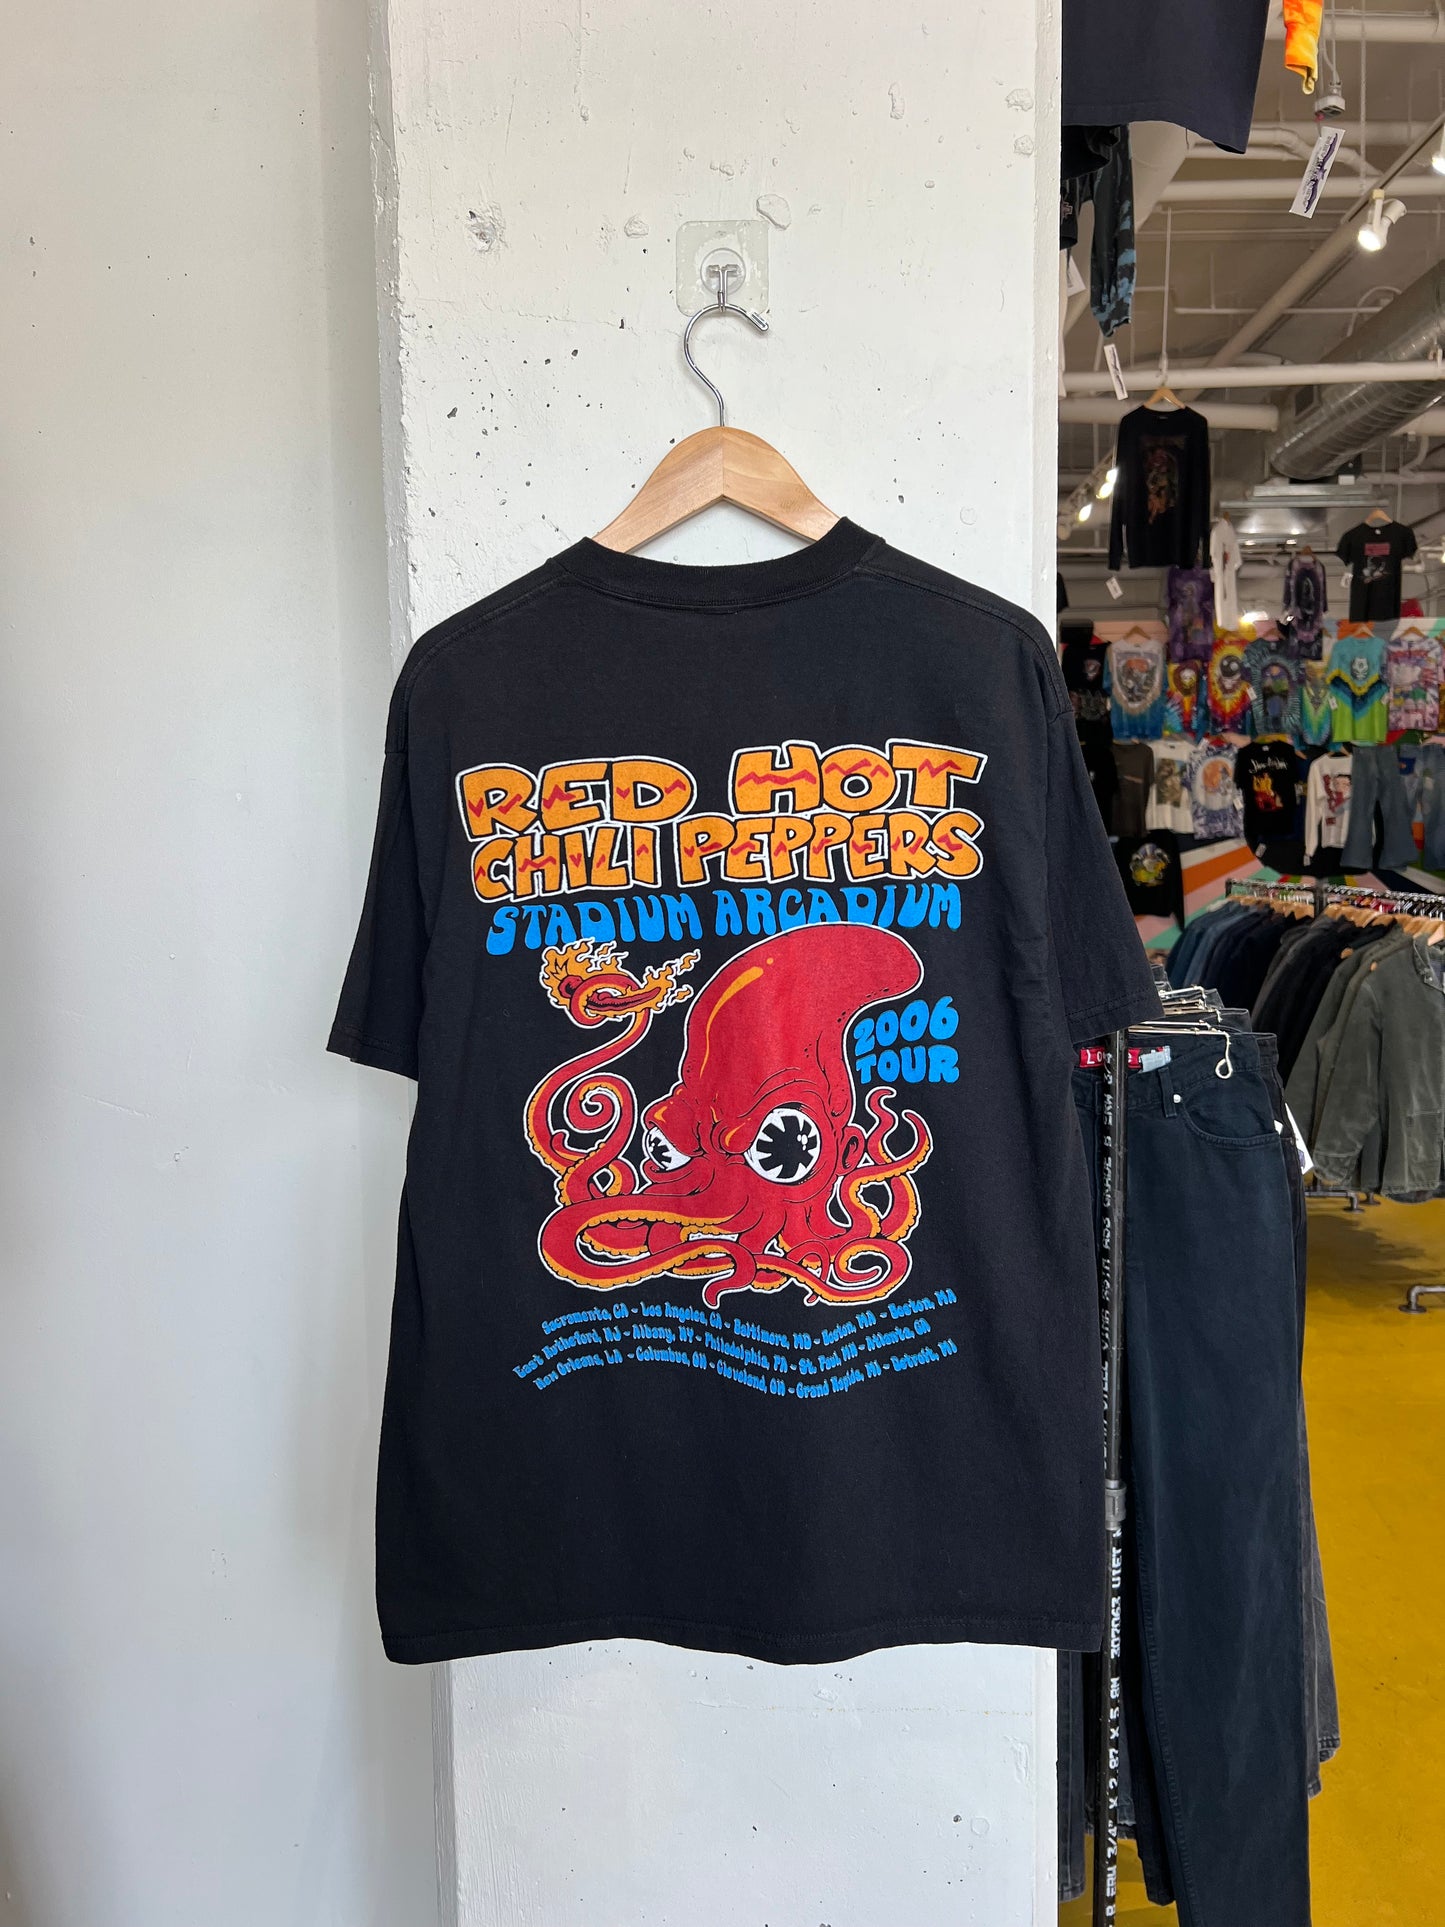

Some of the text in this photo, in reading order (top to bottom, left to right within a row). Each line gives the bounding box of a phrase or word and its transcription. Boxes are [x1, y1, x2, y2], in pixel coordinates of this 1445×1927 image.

[456, 739, 987, 840] RED HOT
[471, 809, 984, 902] CHILI PEPPERS
[486, 883, 961, 955] STADIUM ARCADIUM
[854, 996, 959, 1056] 2006
[856, 1044, 959, 1084] TOUR
[613, 1302, 629, 1319] CA
[640, 1301, 662, 1317] Los
[934, 1288, 957, 1306] MA
[512, 1353, 544, 1379] East
[603, 1348, 624, 1365] LA
[796, 1379, 830, 1399] Grand
